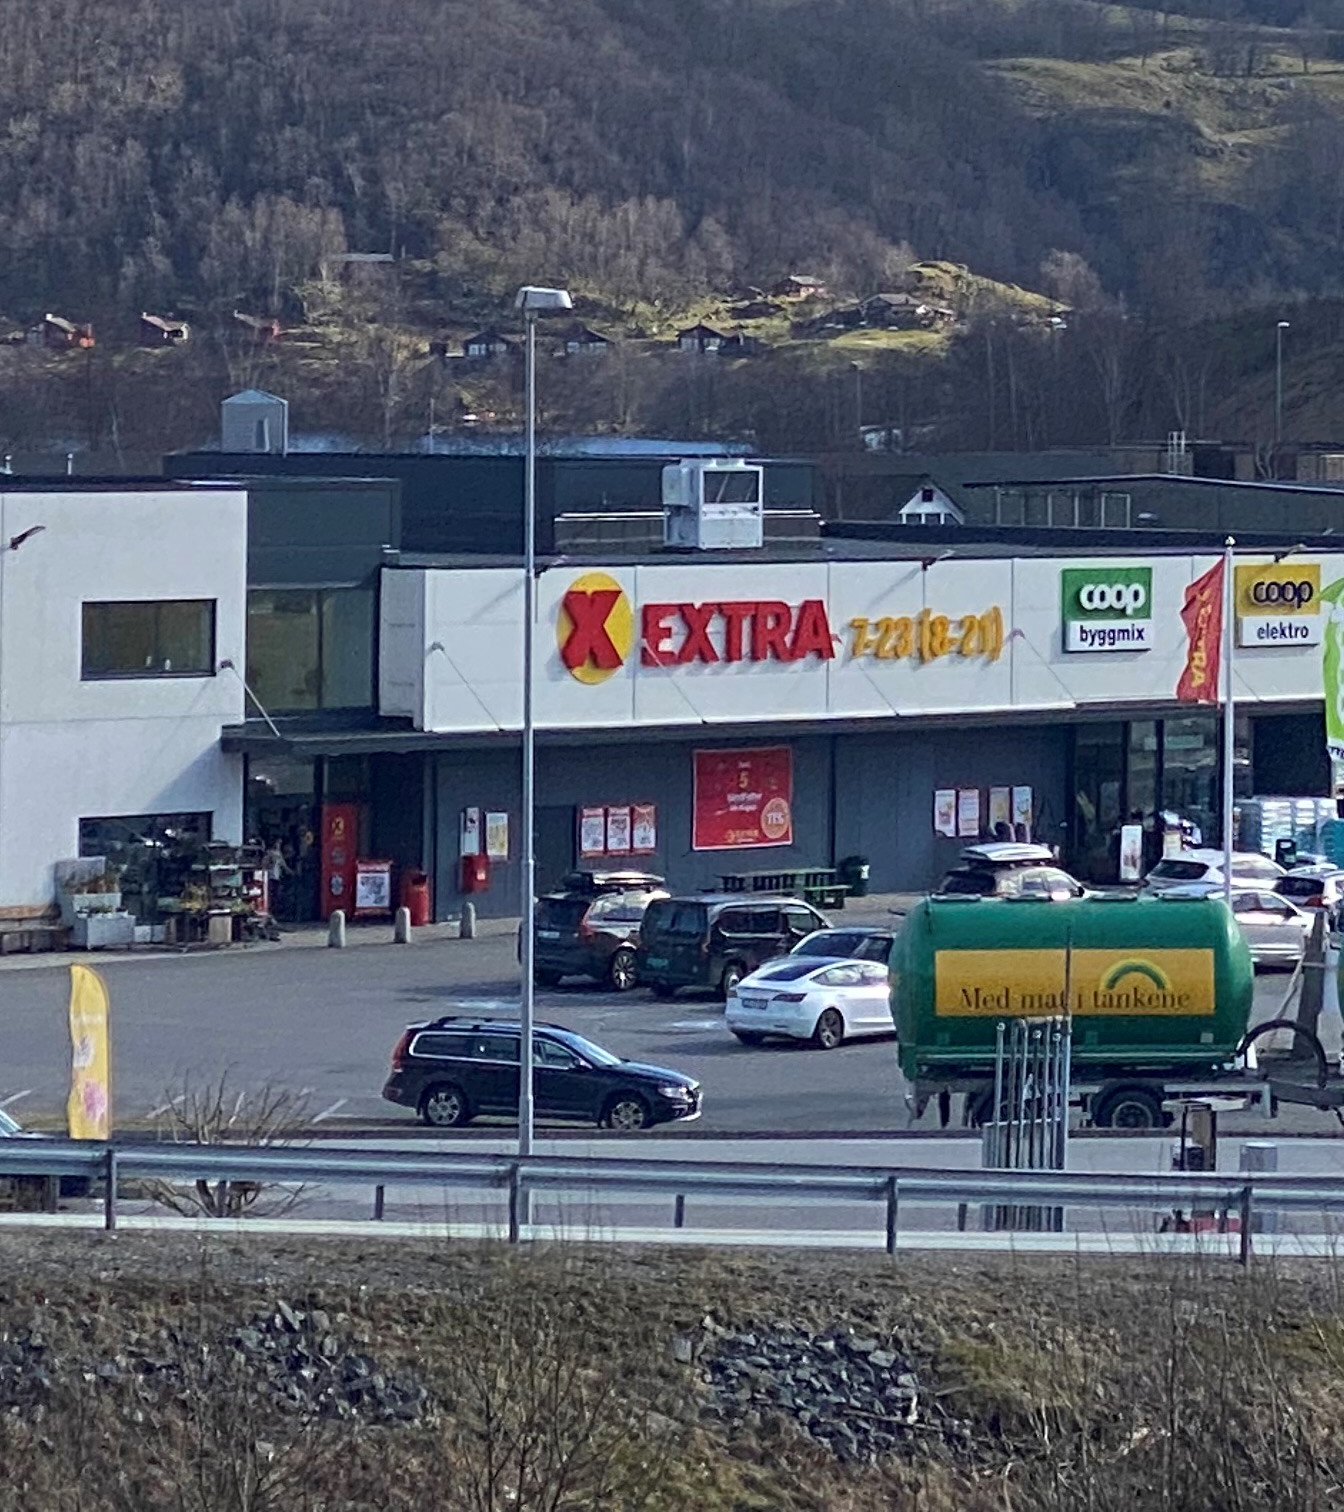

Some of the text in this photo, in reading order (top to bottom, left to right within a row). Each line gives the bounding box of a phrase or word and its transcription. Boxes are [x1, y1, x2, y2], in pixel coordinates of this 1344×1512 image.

[1079, 583, 1146, 615] coop
[1252, 581, 1314, 609] coop
[560, 590, 624, 670] X
[639, 599, 836, 667] EXTRA
[1079, 623, 1146, 646] byggmix
[1256, 624, 1309, 640] elektro
[959, 987, 1010, 1011] Med
[1093, 986, 1191, 1011] tankene
